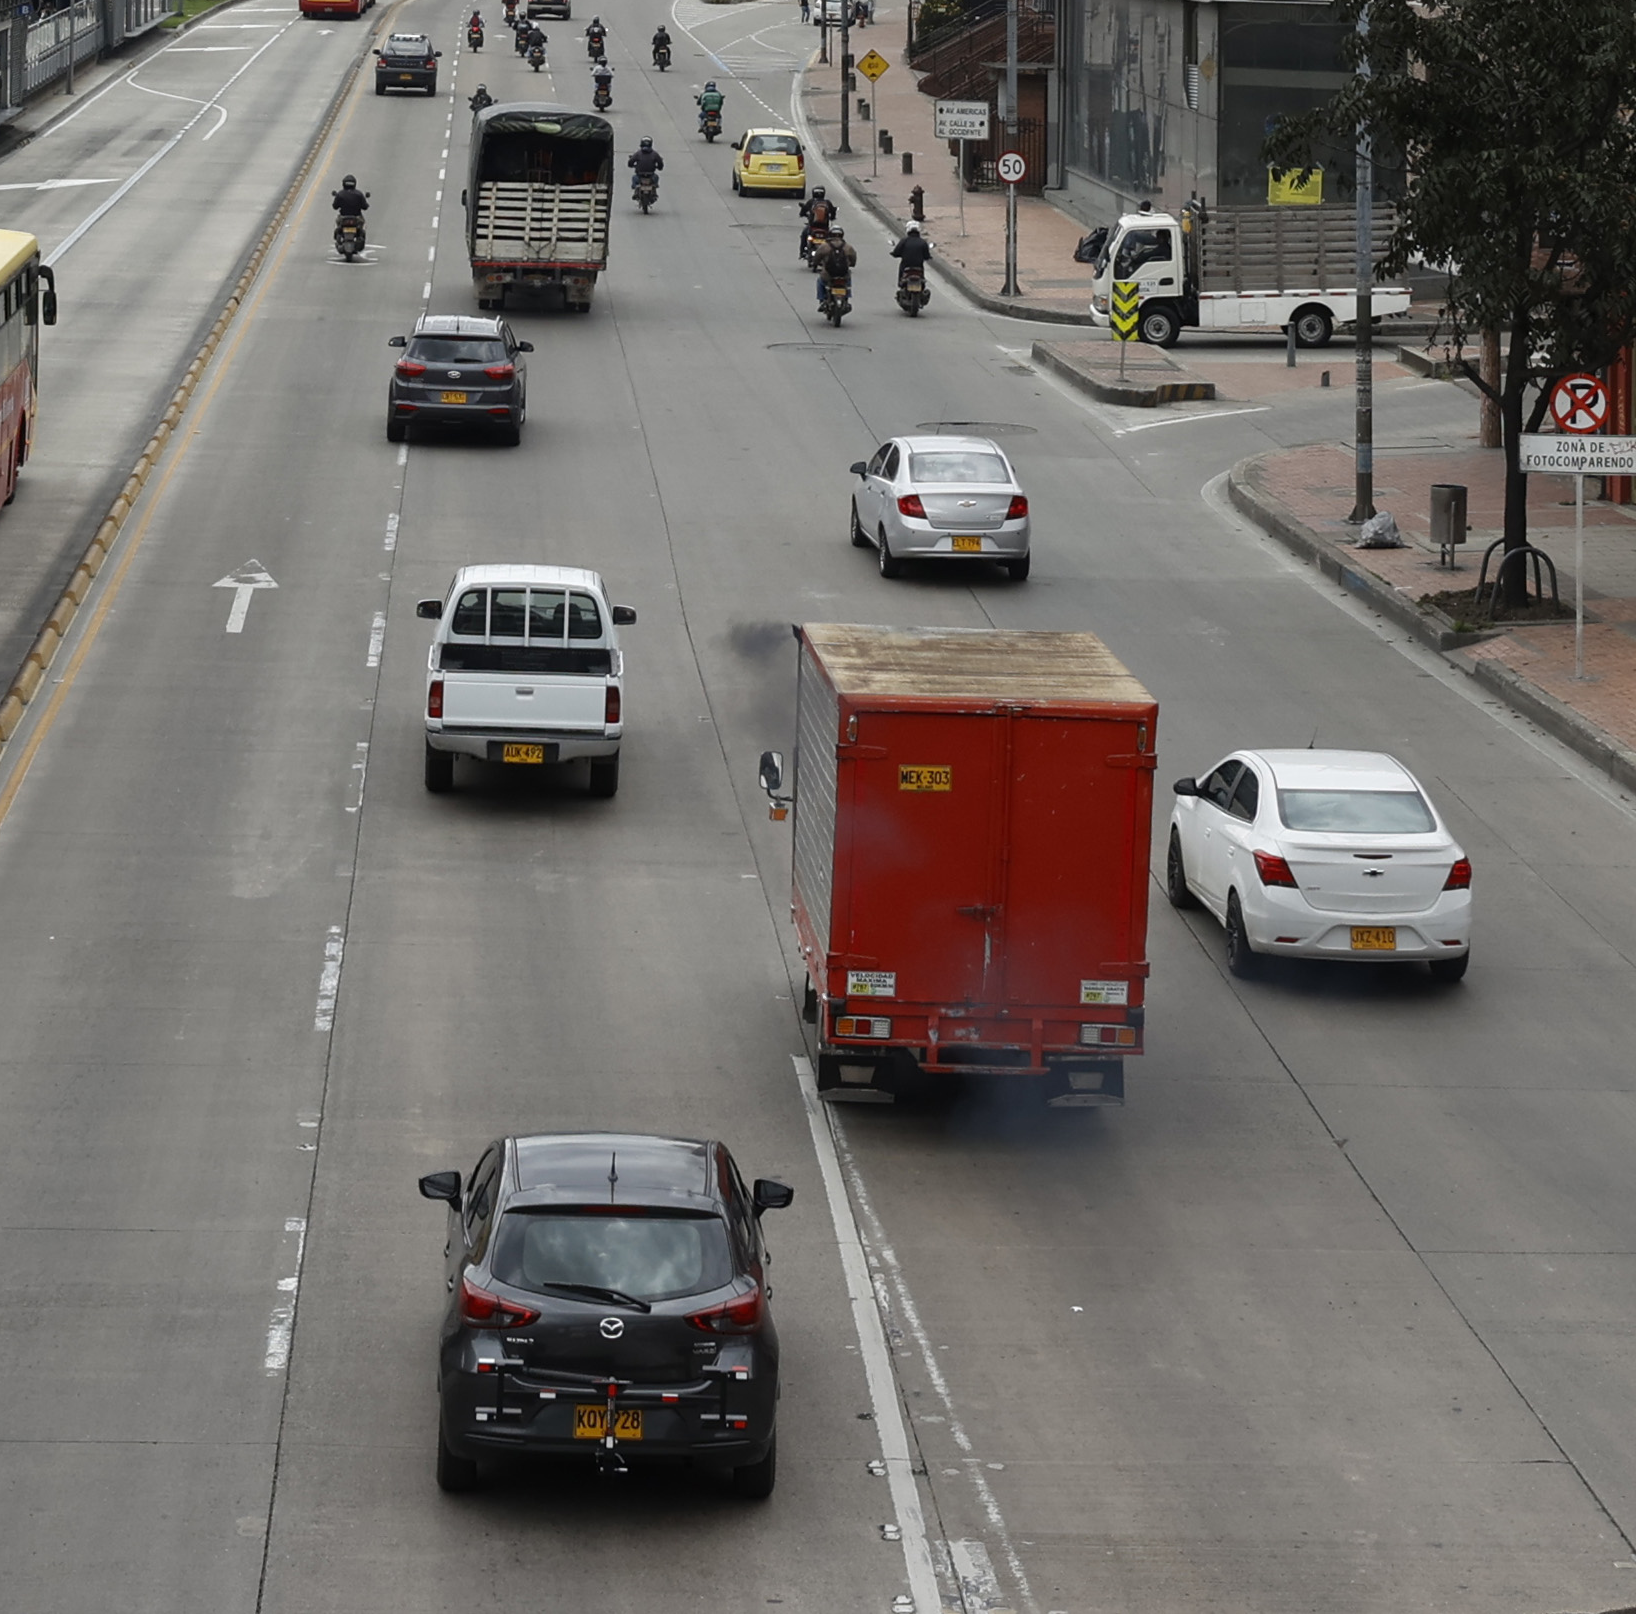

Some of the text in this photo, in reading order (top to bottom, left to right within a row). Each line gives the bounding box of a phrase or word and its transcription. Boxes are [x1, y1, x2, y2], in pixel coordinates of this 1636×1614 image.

[956, 108, 986, 116] AMERICAS
[950, 120, 967, 128] CALLE
[1002, 159, 1022, 175] 50
[1556, 441, 1586, 453] ZONA
[1590, 442, 1605, 453] DE
[1527, 455, 1634, 468] FOTOCOMPARENDO
